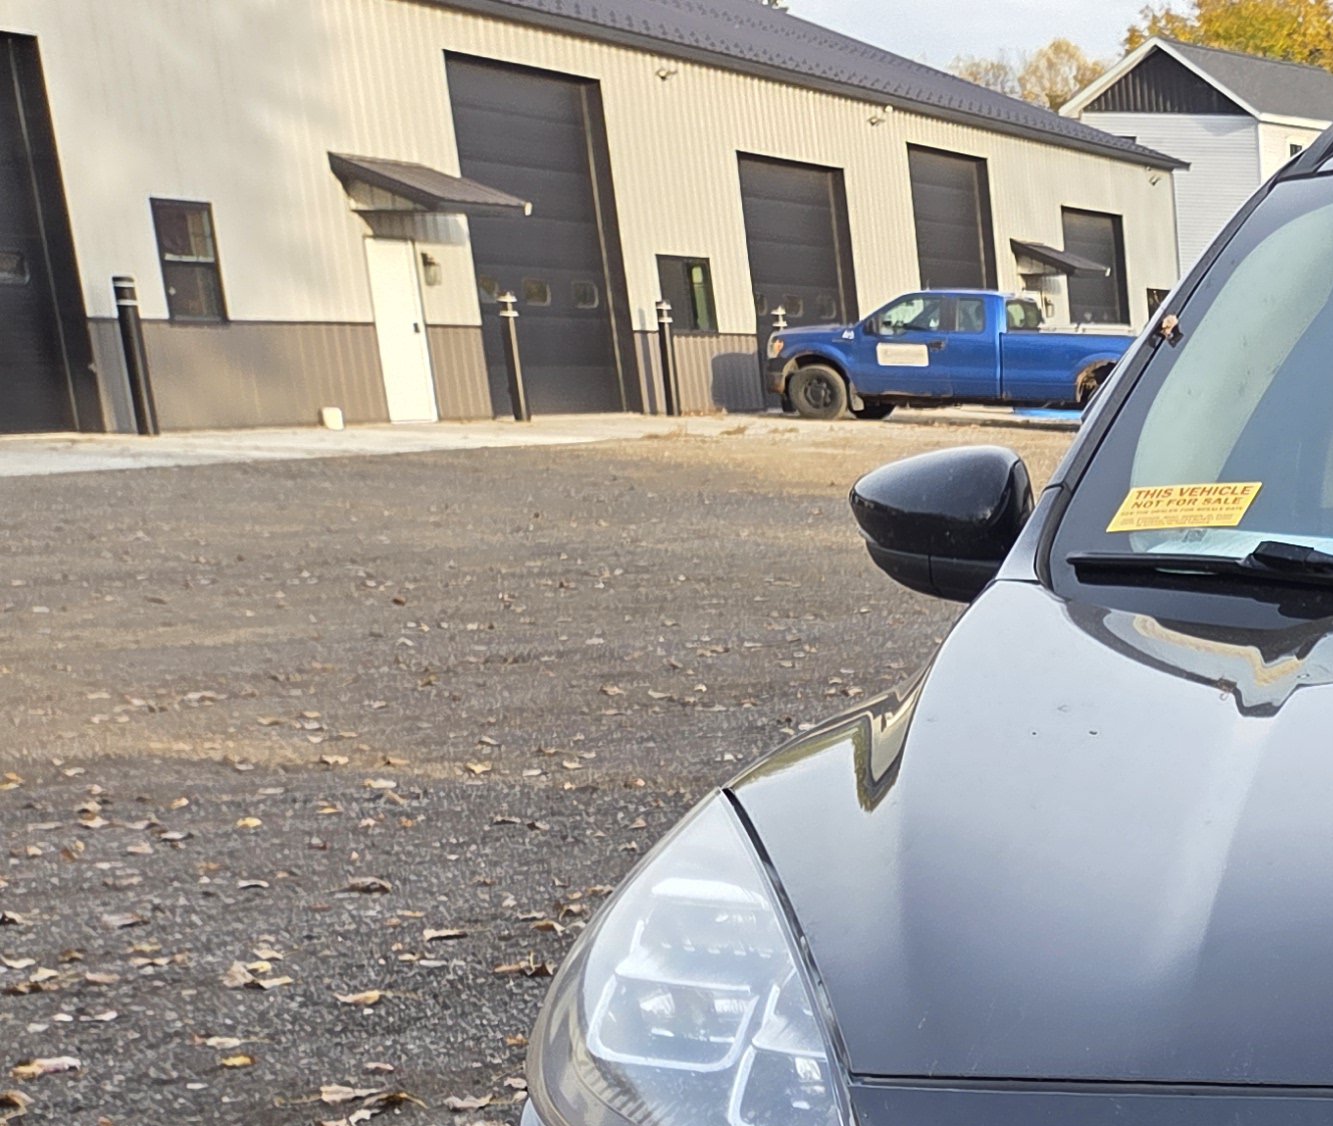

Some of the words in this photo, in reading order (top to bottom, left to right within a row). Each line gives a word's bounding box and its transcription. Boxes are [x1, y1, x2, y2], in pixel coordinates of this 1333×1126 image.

[1136, 488, 1174, 500] THIS
[1179, 485, 1254, 497] VEHICLE
[1131, 500, 1164, 510] NOT
[1166, 498, 1198, 508] FOR
[1201, 496, 1244, 506] SALE
